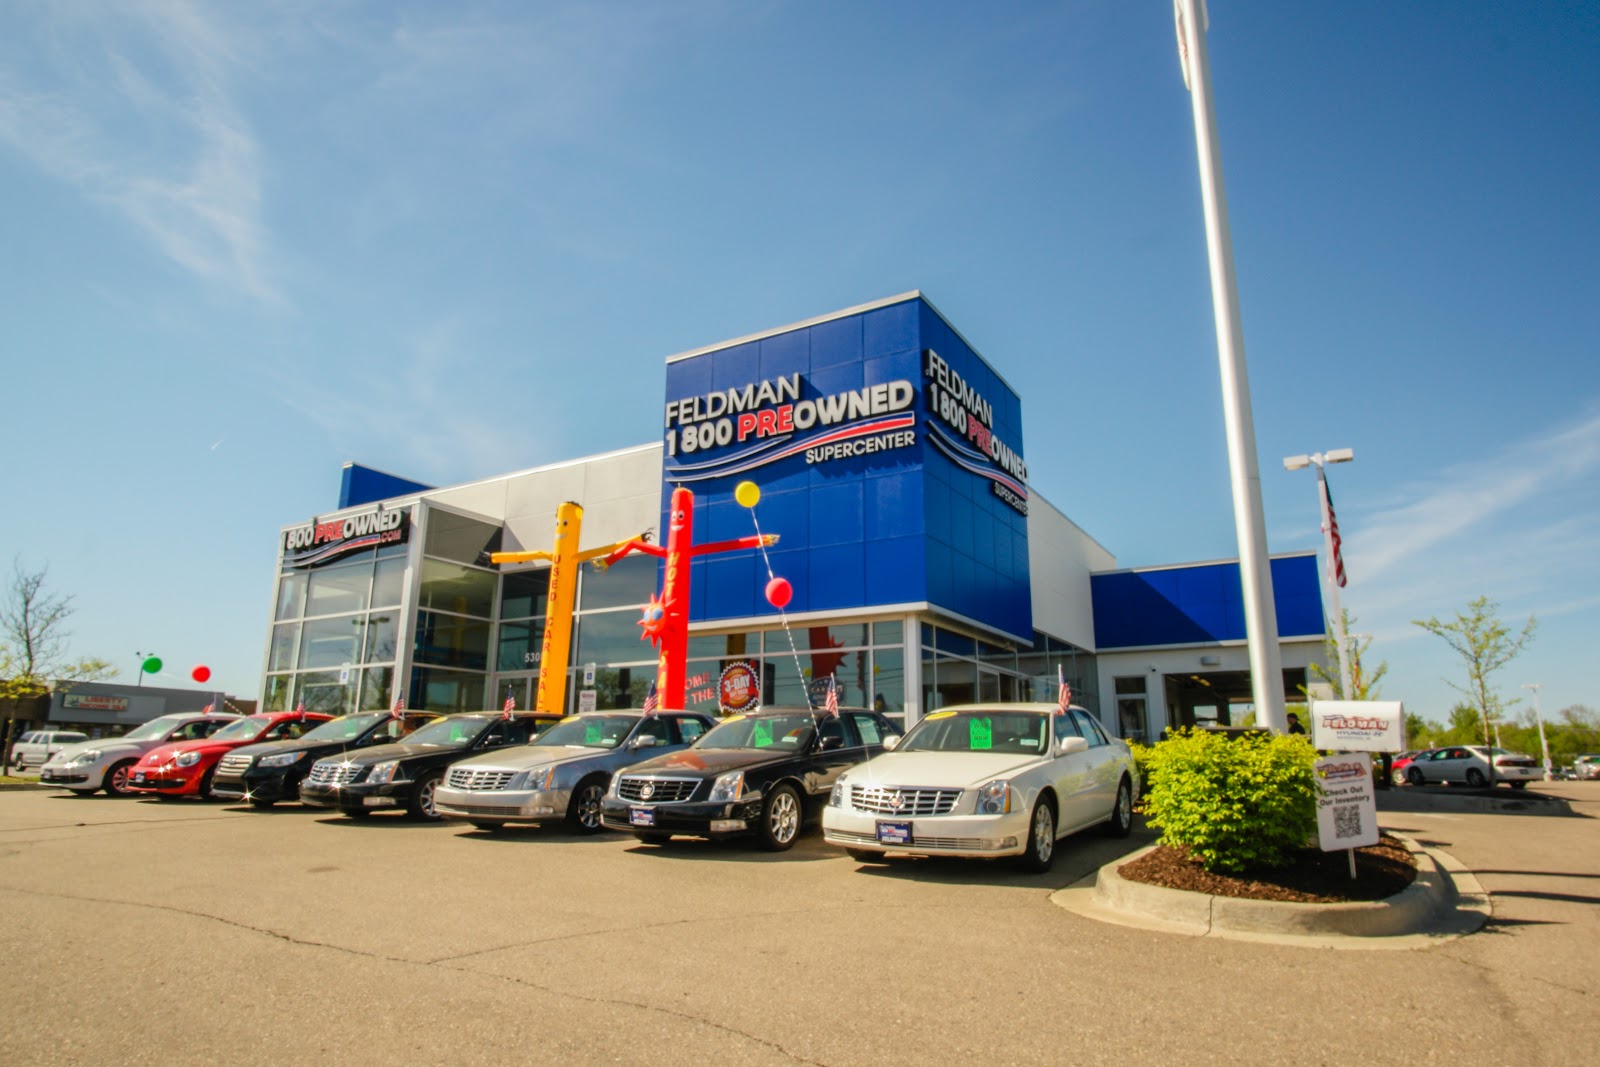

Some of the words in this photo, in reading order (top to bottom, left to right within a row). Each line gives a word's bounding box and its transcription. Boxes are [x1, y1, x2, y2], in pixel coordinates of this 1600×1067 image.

[665, 372, 800, 428] FELDMAN
[929, 348, 993, 429] FELDMAN
[665, 418, 733, 456] 1800
[737, 380, 914, 441] PREOWNED
[930, 382, 967, 435] 1800
[805, 430, 915, 464] SUPERCENTER
[550, 554, 561, 601] USED
[667, 552, 680, 597] HOT
[544, 617, 553, 652] CAR
[691, 686, 715, 704] THE
[724, 674, 750, 693] 3-DAY
[1322, 718, 1389, 731] FELDMAN
[1319, 798, 1333, 806] Our
[1335, 795, 1370, 804] Inventory
[1325, 788, 1348, 797] Check
[1350, 786, 1363, 794] Out
